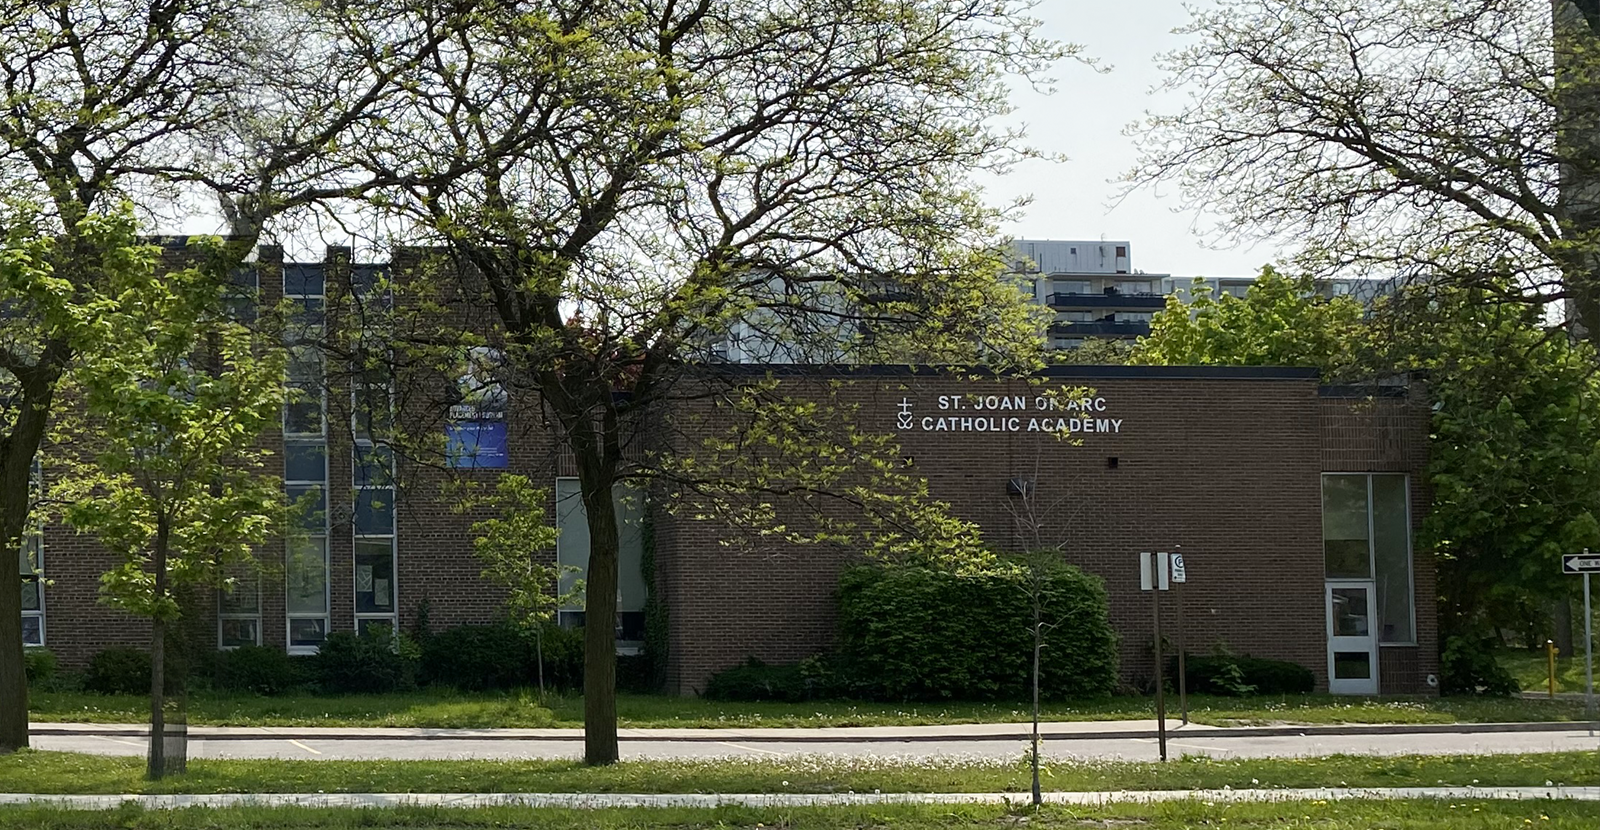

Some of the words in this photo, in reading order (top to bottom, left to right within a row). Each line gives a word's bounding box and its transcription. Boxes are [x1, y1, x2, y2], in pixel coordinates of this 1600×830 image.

[937, 395, 966, 410] ST.
[973, 395, 1026, 411] JOAN
[1066, 397, 1107, 412] ARC
[921, 416, 1021, 432] CATHOLIC
[1026, 417, 1124, 433] ACADEMY
